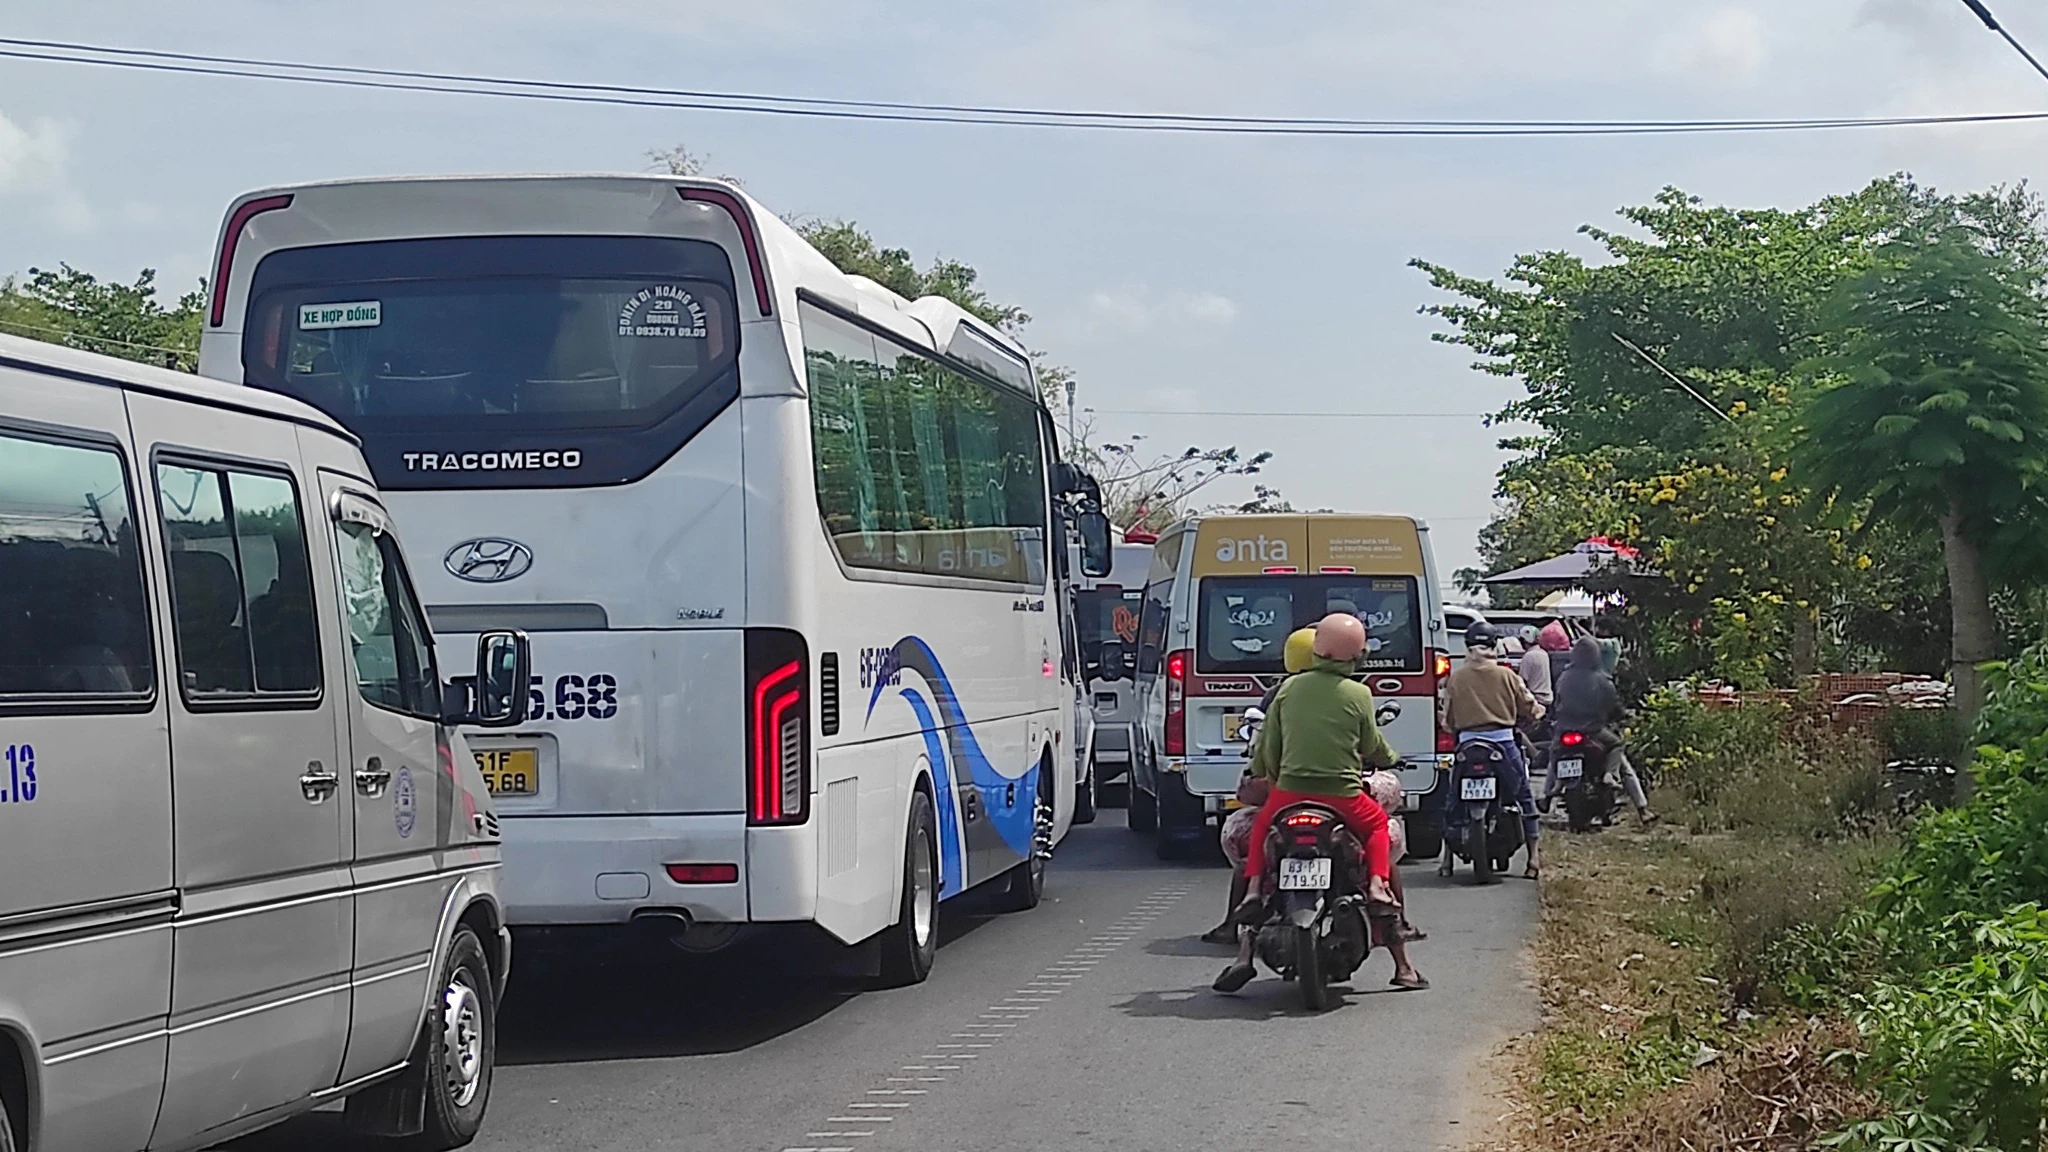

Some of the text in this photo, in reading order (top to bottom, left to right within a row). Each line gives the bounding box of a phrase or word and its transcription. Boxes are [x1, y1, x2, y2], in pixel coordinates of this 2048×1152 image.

[304, 311, 318, 324] XE
[321, 309, 343, 324] HỢP
[403, 451, 581, 470] TRACOMECO
[1216, 533, 1289, 562] anta
[1207, 683, 1252, 691] TRANSIT
[526, 674, 617, 721] 5.68
[483, 773, 526, 791] 5.68
[1282, 874, 1326, 887] 719.56
